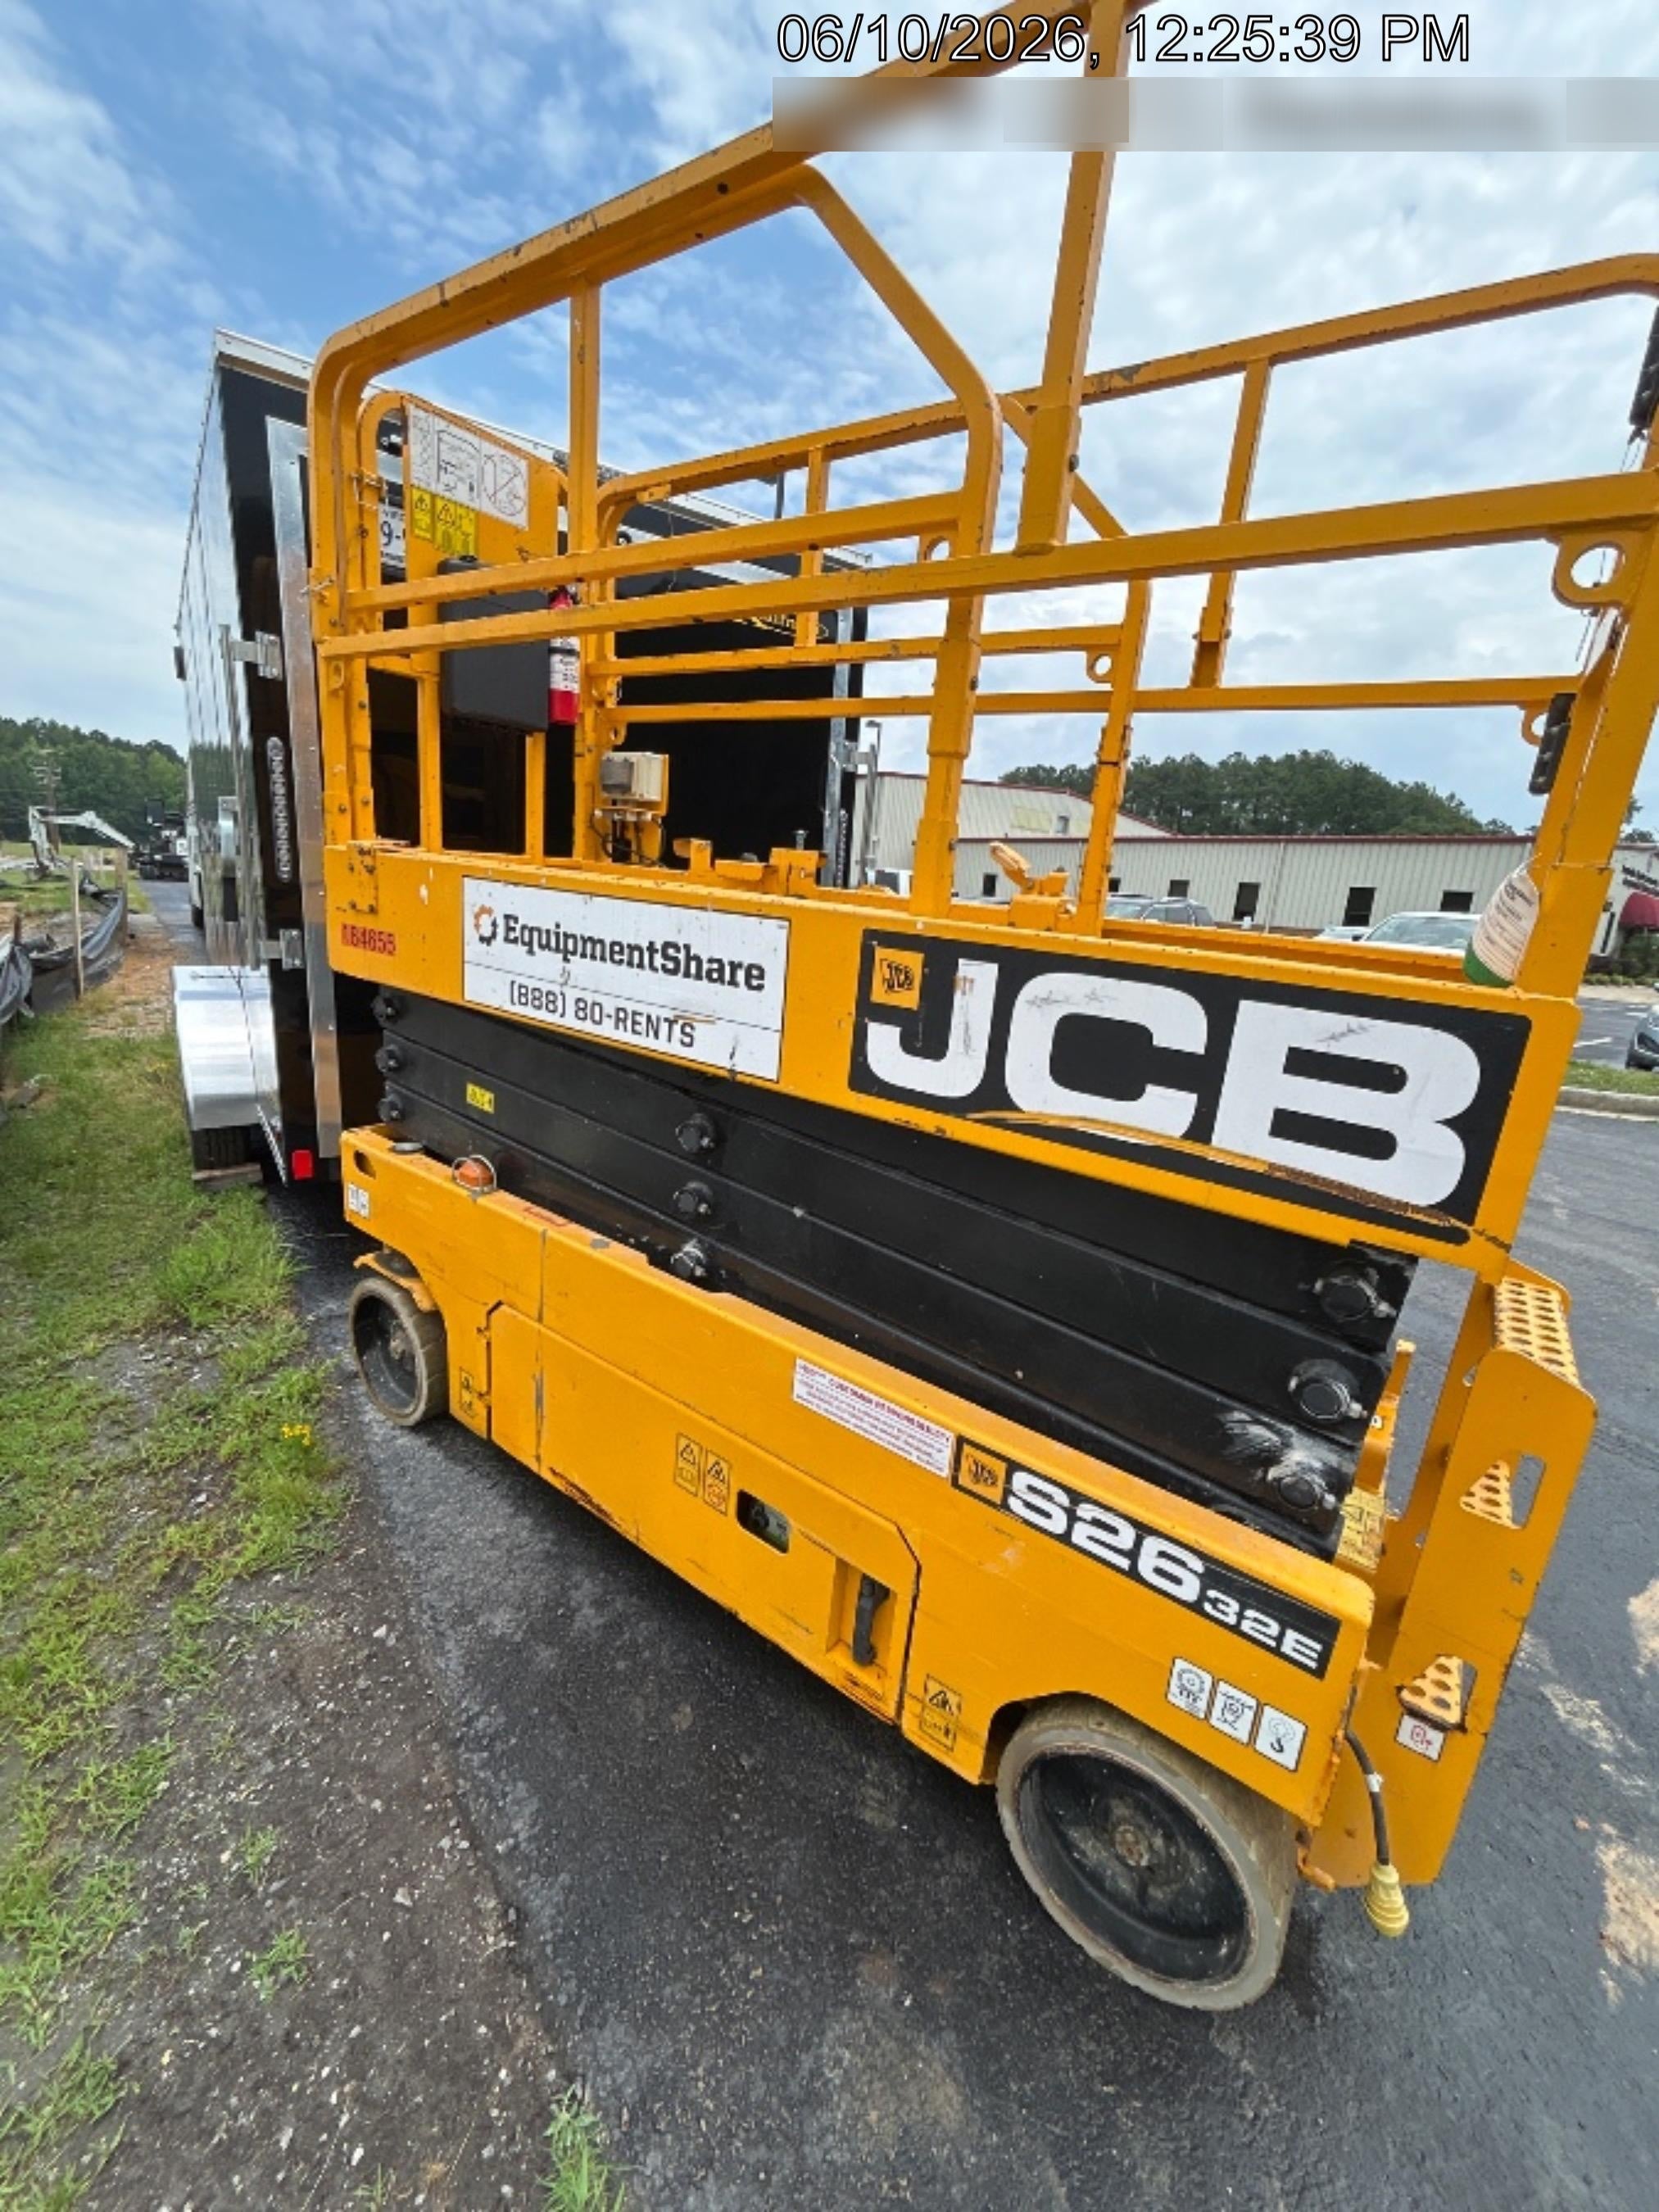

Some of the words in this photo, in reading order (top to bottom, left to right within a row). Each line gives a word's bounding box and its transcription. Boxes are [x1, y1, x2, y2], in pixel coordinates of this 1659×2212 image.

[502, 913, 766, 992] EquipmentShare
[509, 980, 567, 1018] (888)
[574, 996, 696, 1049] 80-RENTS
[866, 957, 1481, 1208] JCB
